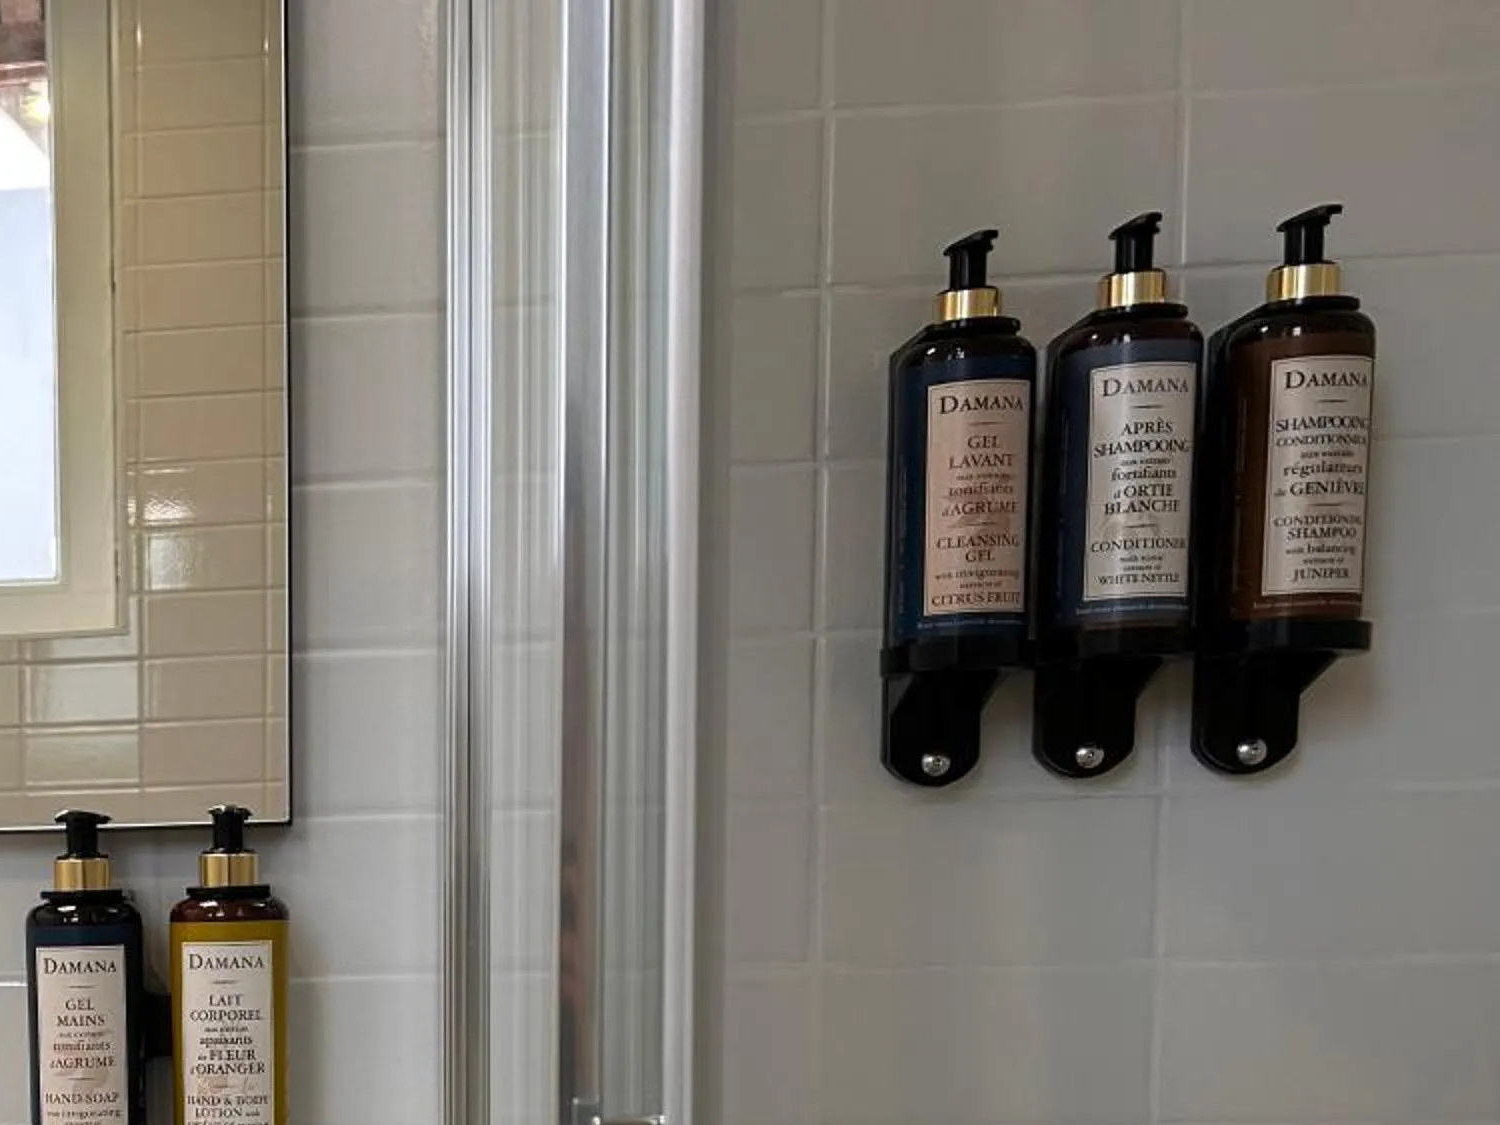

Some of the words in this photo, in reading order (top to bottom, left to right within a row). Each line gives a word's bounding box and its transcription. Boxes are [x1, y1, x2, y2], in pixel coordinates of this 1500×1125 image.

[1283, 369, 1368, 390] DAMANA
[1102, 377, 1189, 397] DAMANA
[938, 394, 1024, 415] DAMANA
[1121, 417, 1174, 435] APRÈS
[967, 435, 1002, 449] GEL
[948, 453, 1016, 470] LAVANT
[1104, 500, 1180, 515] BLANCHE
[936, 532, 1021, 549] CLEANSING
[1287, 527, 1357, 540] SHAMPOO
[965, 549, 996, 563] GEL
[43, 957, 117, 975] DAMANA
[188, 953, 265, 970] DAMANA
[65, 999, 96, 1011] GEL
[209, 994, 244, 1007] LAIT
[57, 1015, 106, 1027] MAINS
[189, 1009, 264, 1022] CORPOREL
[209, 1049, 257, 1061] FLEUR
[195, 1107, 242, 1119] LOTION
